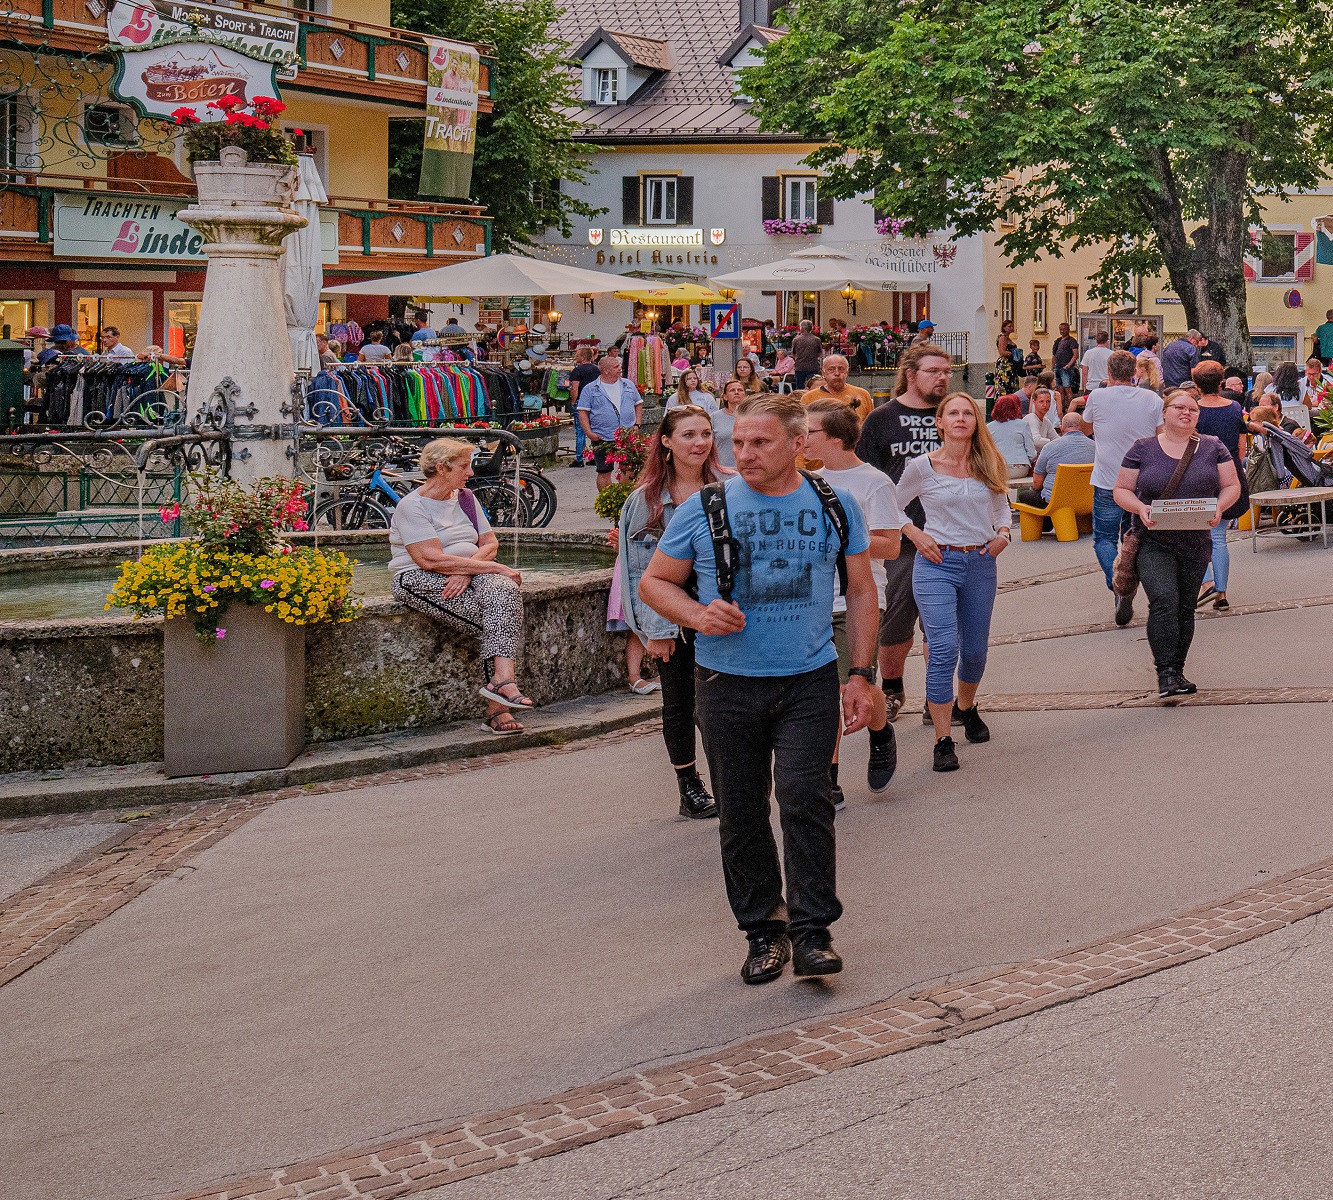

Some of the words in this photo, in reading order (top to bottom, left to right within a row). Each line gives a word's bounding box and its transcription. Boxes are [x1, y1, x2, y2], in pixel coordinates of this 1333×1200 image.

[260, 23, 295, 40] TRACHT
[166, 81, 240, 101] Boten
[426, 115, 475, 142] TRACHT
[83, 196, 161, 220] TRACHTEN
[111, 220, 207, 256] Linde
[611, 229, 701, 245] Restaurant
[595, 249, 641, 265] Hotel
[651, 249, 718, 264] Austria
[898, 415, 939, 427] DRO
[909, 427, 939, 440] THE
[890, 441, 945, 457] FUCKIN
